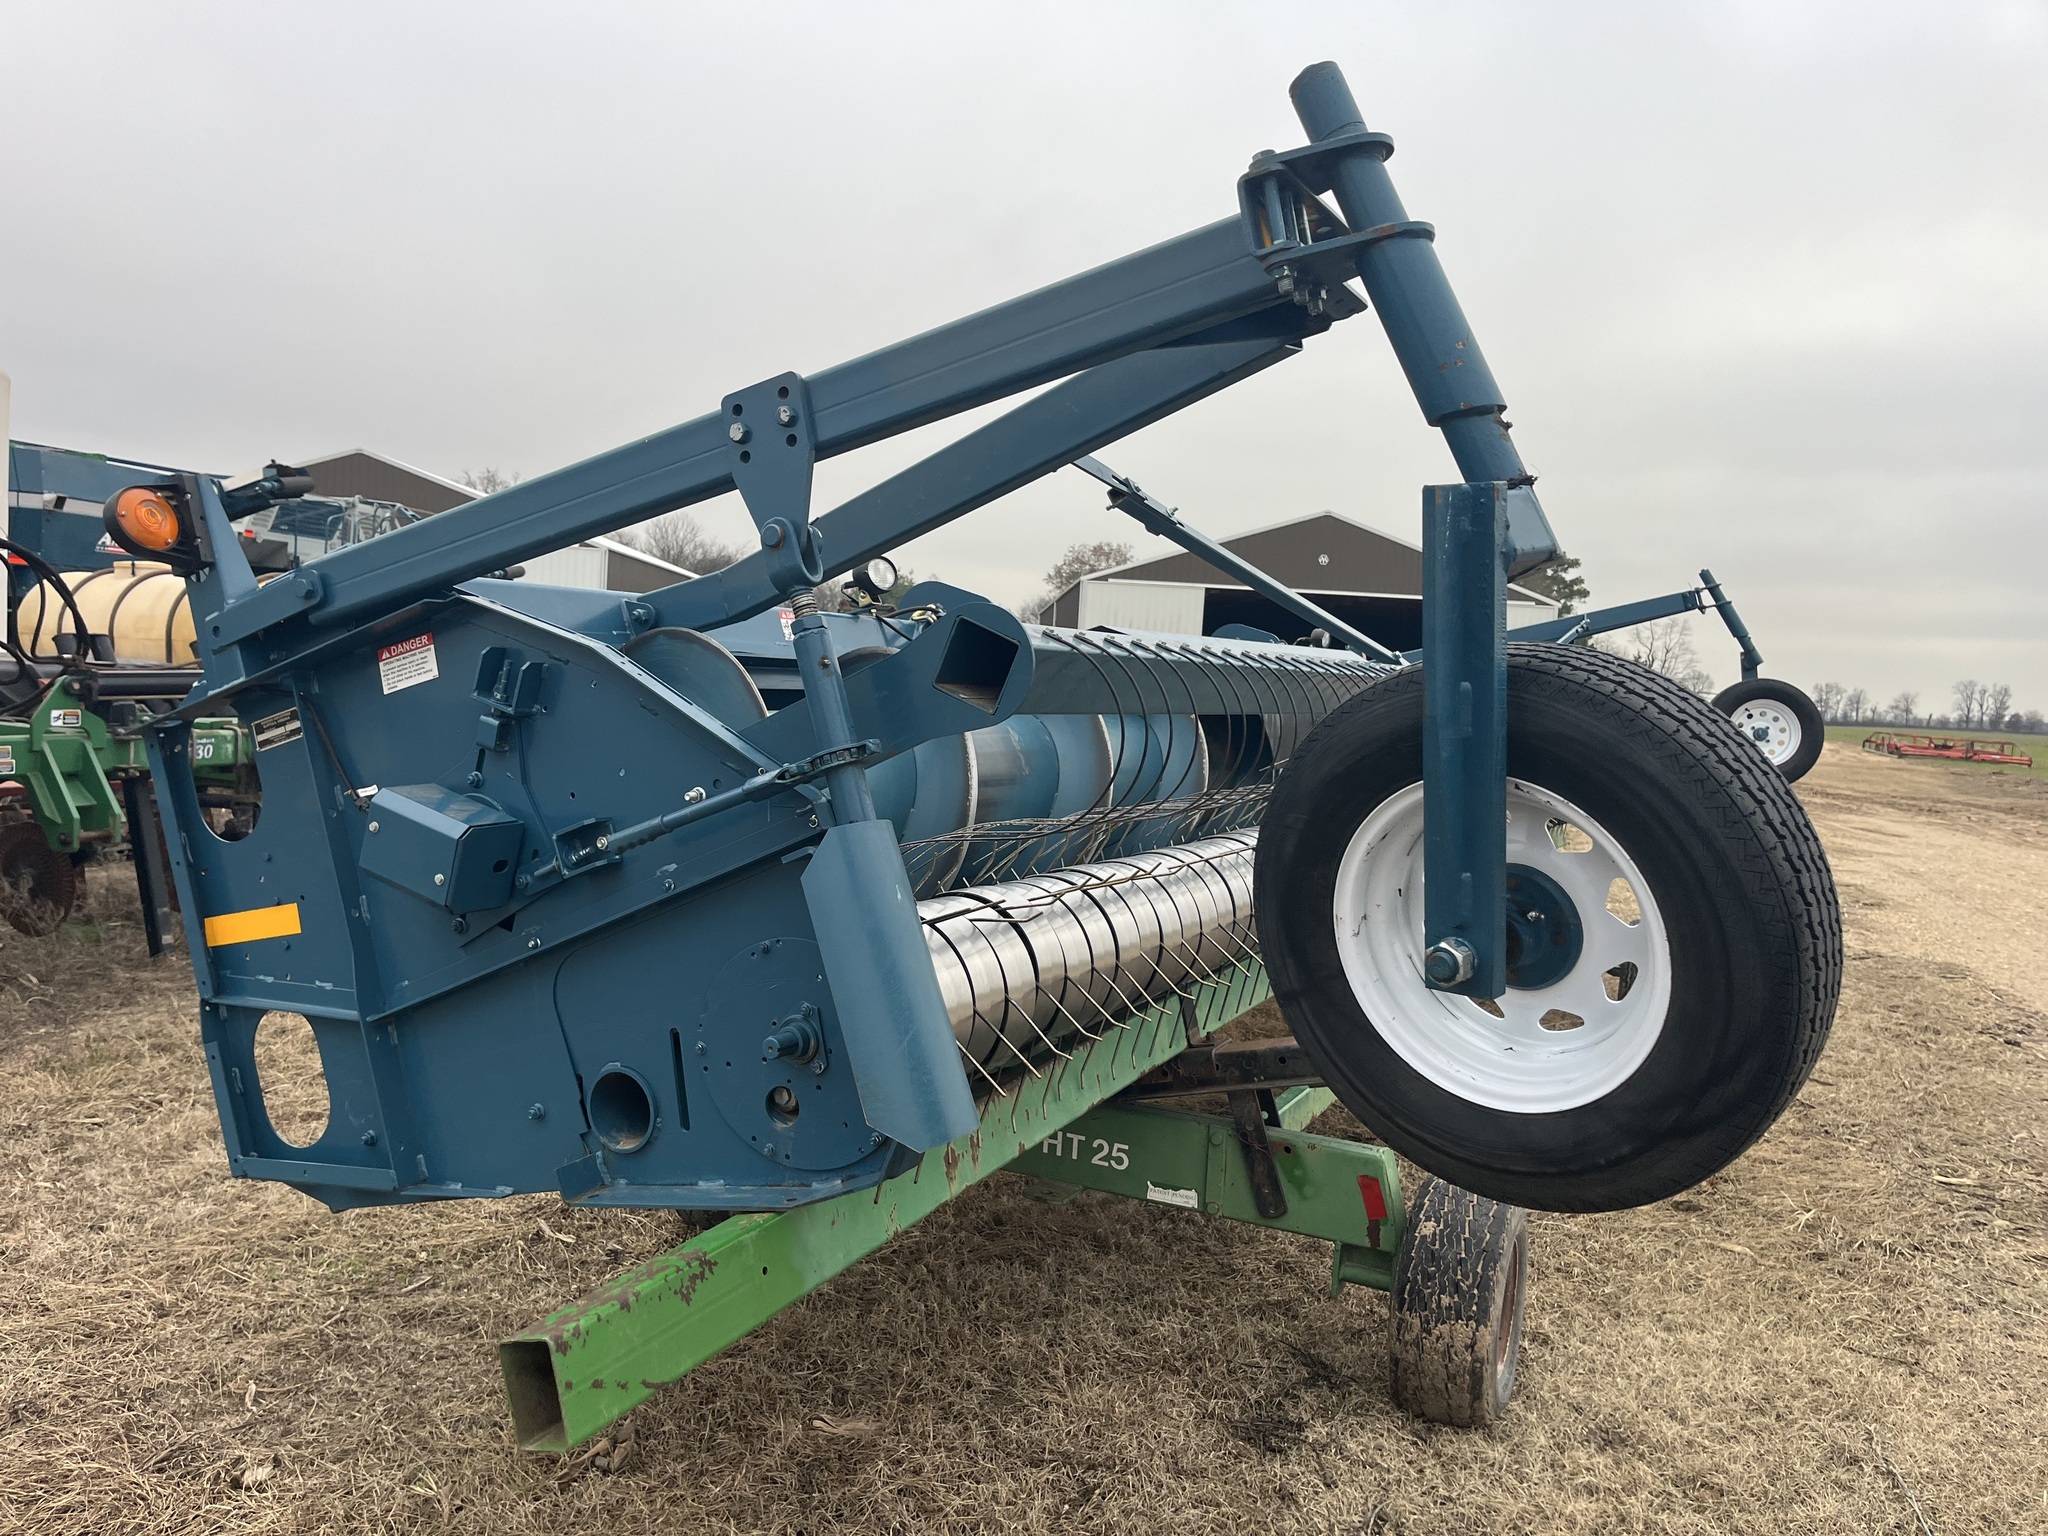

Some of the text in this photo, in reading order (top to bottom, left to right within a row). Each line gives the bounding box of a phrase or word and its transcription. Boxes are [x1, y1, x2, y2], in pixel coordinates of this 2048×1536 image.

[391, 635, 429, 656] DANGER
[383, 657, 401, 666] OPERATING
[1042, 1130, 1130, 1170] HT 25
[1150, 1188, 1170, 1196] PATENT
